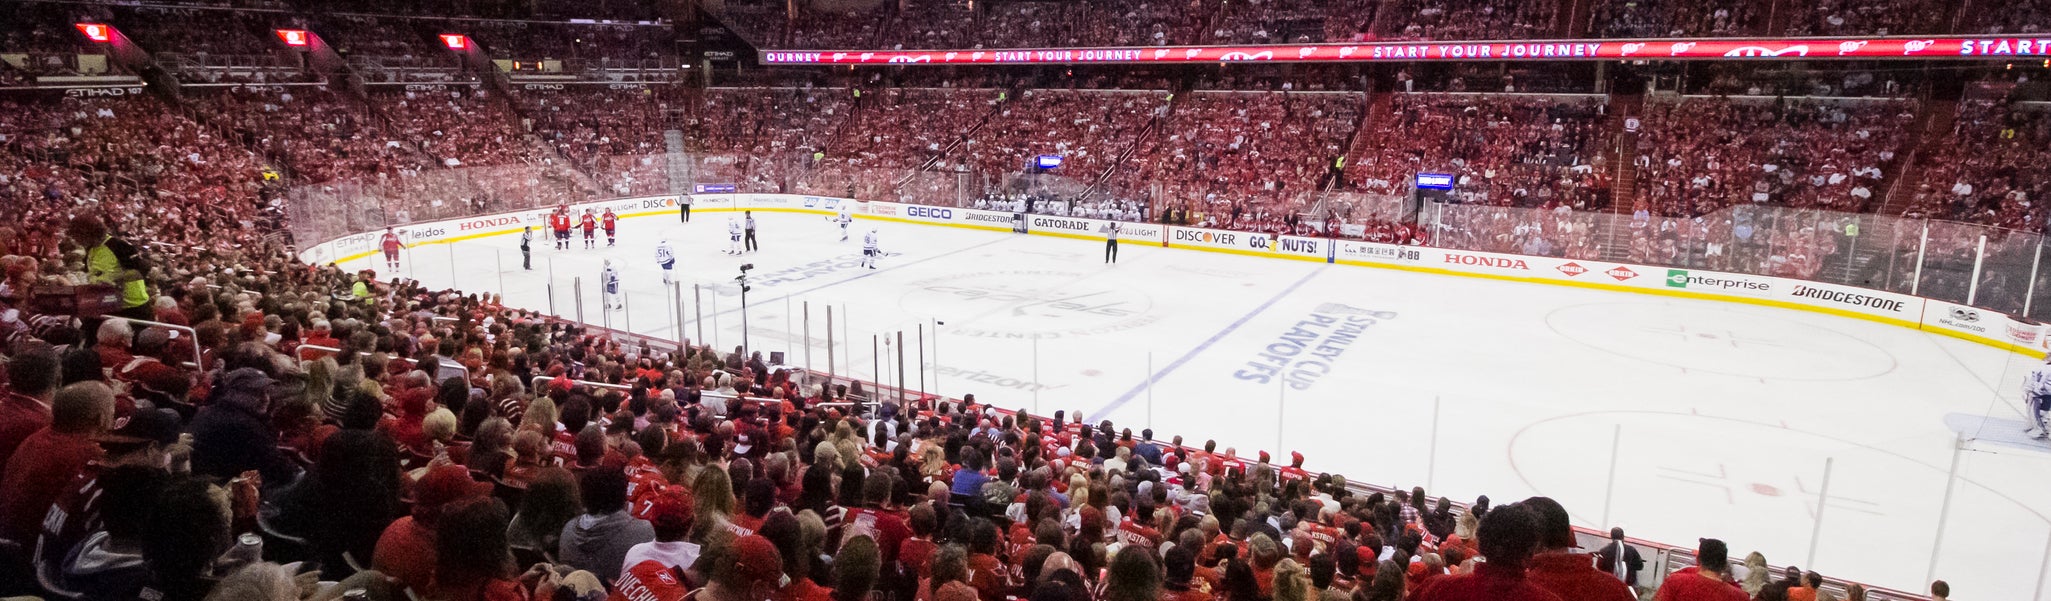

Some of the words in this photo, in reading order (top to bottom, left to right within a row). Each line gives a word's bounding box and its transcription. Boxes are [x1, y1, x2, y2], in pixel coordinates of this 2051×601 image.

[1373, 46, 1429, 57] START
[1439, 45, 1491, 57] YOUR
[1501, 43, 1600, 57] JOURNEY
[1960, 39, 2051, 55] START
[767, 52, 821, 62] OURNEY
[995, 51, 1031, 62] START
[1037, 50, 1073, 61] YOUR
[1078, 50, 1142, 60] JOURNEY
[65, 88, 125, 97] ETIHAD
[907, 206, 952, 219] GEICO
[965, 212, 1015, 224] BRIDGESTONE
[459, 214, 521, 231] HONDA
[1034, 218, 1089, 231] GATORADE
[336, 233, 375, 248] ETIHAD
[411, 227, 445, 239] leidos
[1134, 229, 1157, 237] LIGHT
[1176, 229, 1236, 245] DISCOVER
[1250, 235, 1266, 248] GO
[1281, 238, 1317, 254] NUTS!
[657, 248, 666, 258] 51
[1407, 250, 1420, 261] 88
[1444, 253, 1530, 270] HONDA
[1670, 271, 1770, 292] enterprise
[1791, 284, 1905, 313] BRIDGESTONE
[1310, 315, 1377, 363] STANLEY
[1233, 313, 1339, 385] PLAYOFFS
[1283, 360, 1331, 390] CUP
[640, 499, 653, 516] 7
